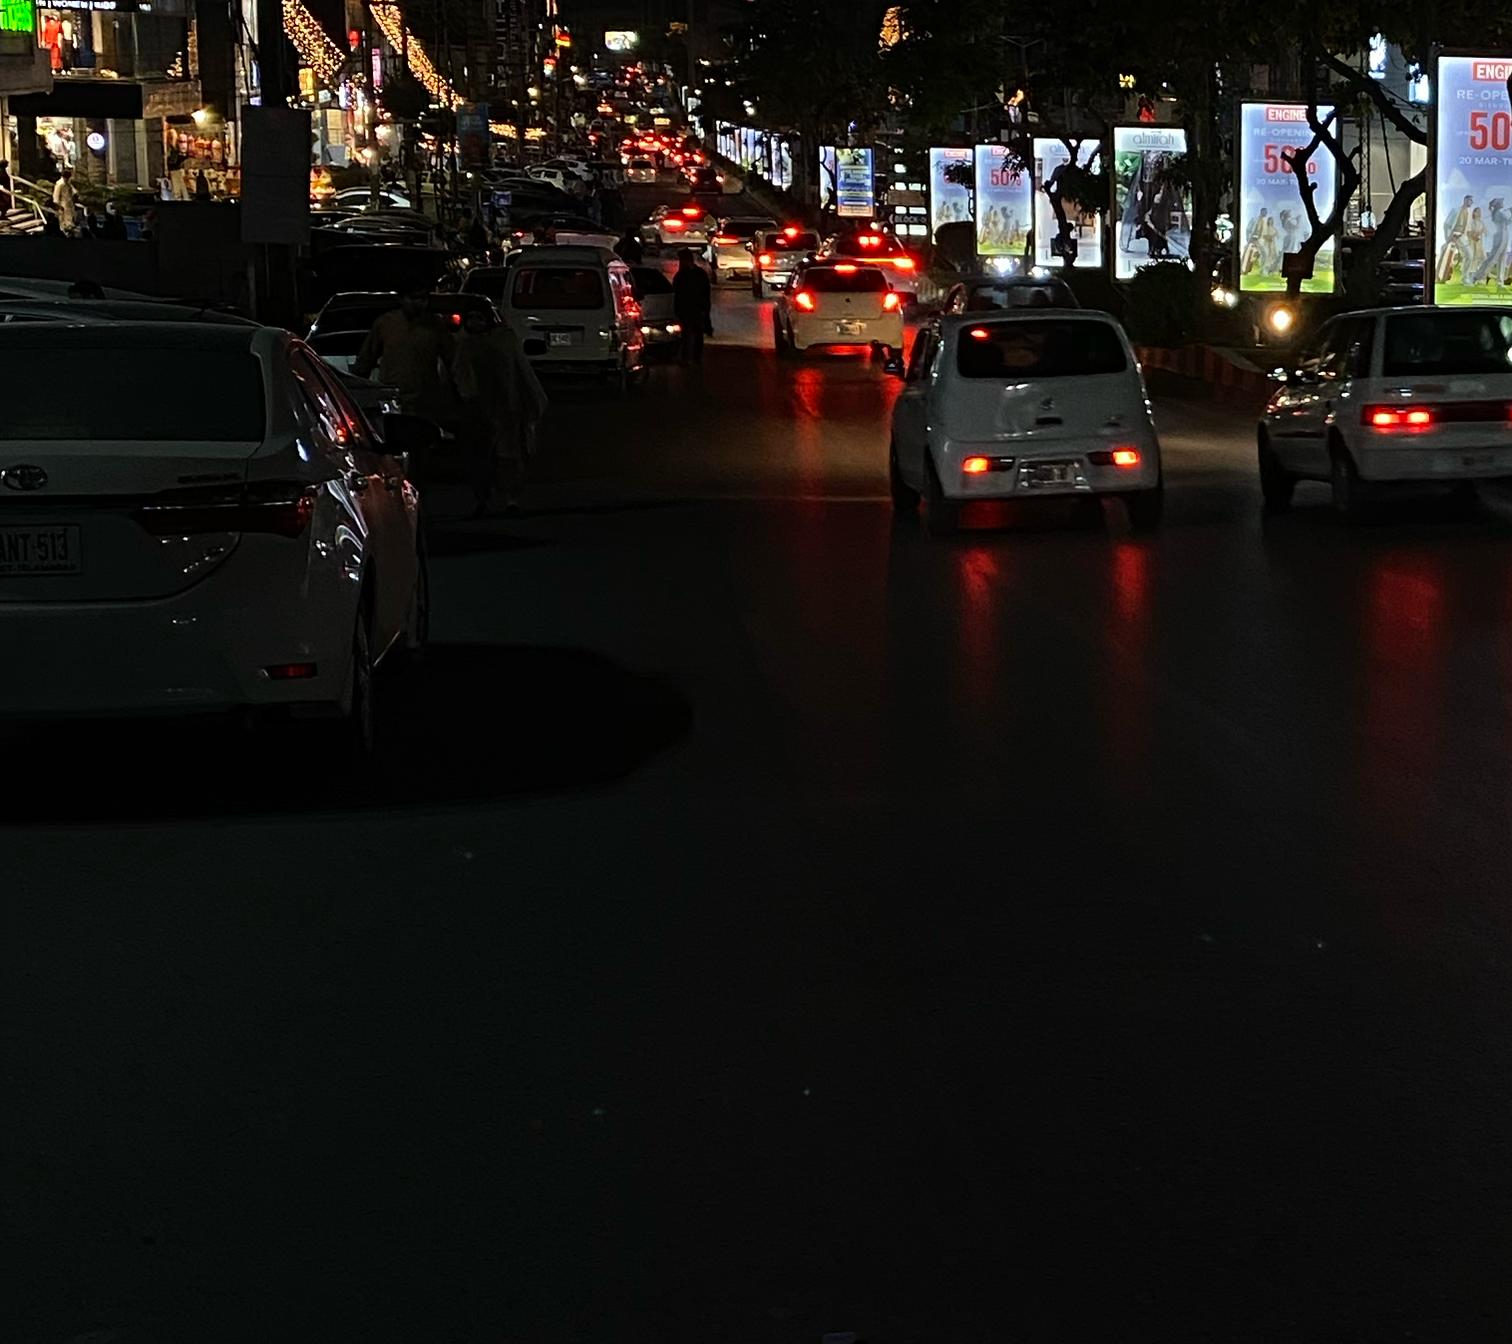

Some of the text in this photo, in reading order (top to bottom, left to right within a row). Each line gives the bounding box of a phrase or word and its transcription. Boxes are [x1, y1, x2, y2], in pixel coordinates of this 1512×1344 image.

[1268, 109, 1306, 121] ENGINE
[1133, 131, 1174, 145] almirah
[1460, 156, 1472, 165] 20
